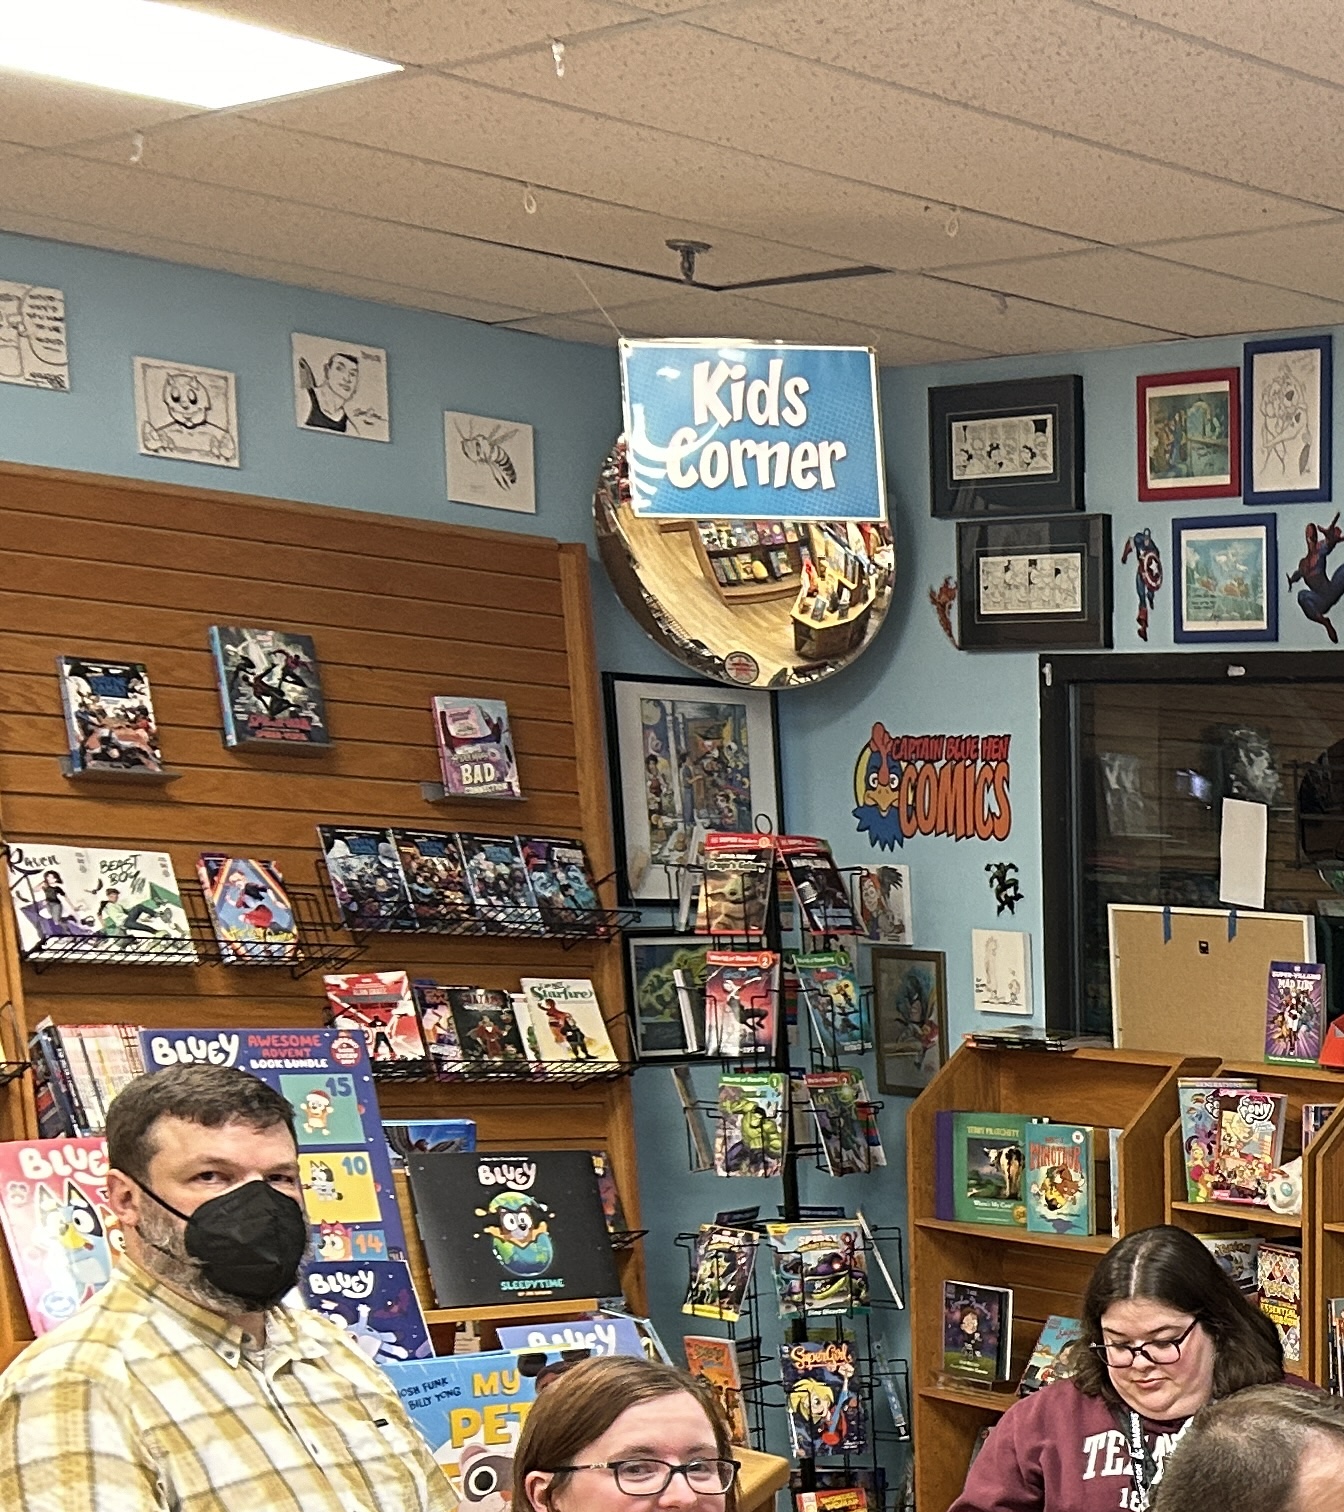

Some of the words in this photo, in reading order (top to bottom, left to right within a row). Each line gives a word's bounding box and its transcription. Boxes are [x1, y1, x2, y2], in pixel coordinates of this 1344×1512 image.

[692, 360, 809, 429] Kids
[664, 432, 848, 492] Corner
[891, 734, 946, 762] CAPTAIN
[945, 735, 980, 761] BLUE
[981, 734, 1011, 760] HEN
[460, 763, 495, 784] BAD
[899, 760, 1011, 842] COMICS
[100, 854, 141, 874] BEAST
[109, 871, 139, 886] BOY
[530, 986, 594, 1000] Starfire
[1278, 979, 1295, 989] MAD
[151, 1032, 239, 1068] BLUEY
[248, 1034, 322, 1049] AWESOME
[250, 1059, 280, 1069] BOOK
[282, 1058, 329, 1069] BUNDLE
[262, 1047, 311, 1059] ADVENT
[325, 1076, 351, 1097] 15
[1240, 1102, 1273, 1123] PONY
[341, 1156, 368, 1176] 10
[477, 1163, 537, 1190] BLUEY
[356, 1236, 383, 1252] 14
[310, 1270, 374, 1299] BLUEY
[500, 1279, 565, 1290] SLEEPYTIME
[422, 1377, 449, 1393] FUNK
[473, 1369, 521, 1398] MY
[408, 1397, 432, 1410] BILLY
[435, 1387, 461, 1401] YONG
[450, 1403, 533, 1448] PET
